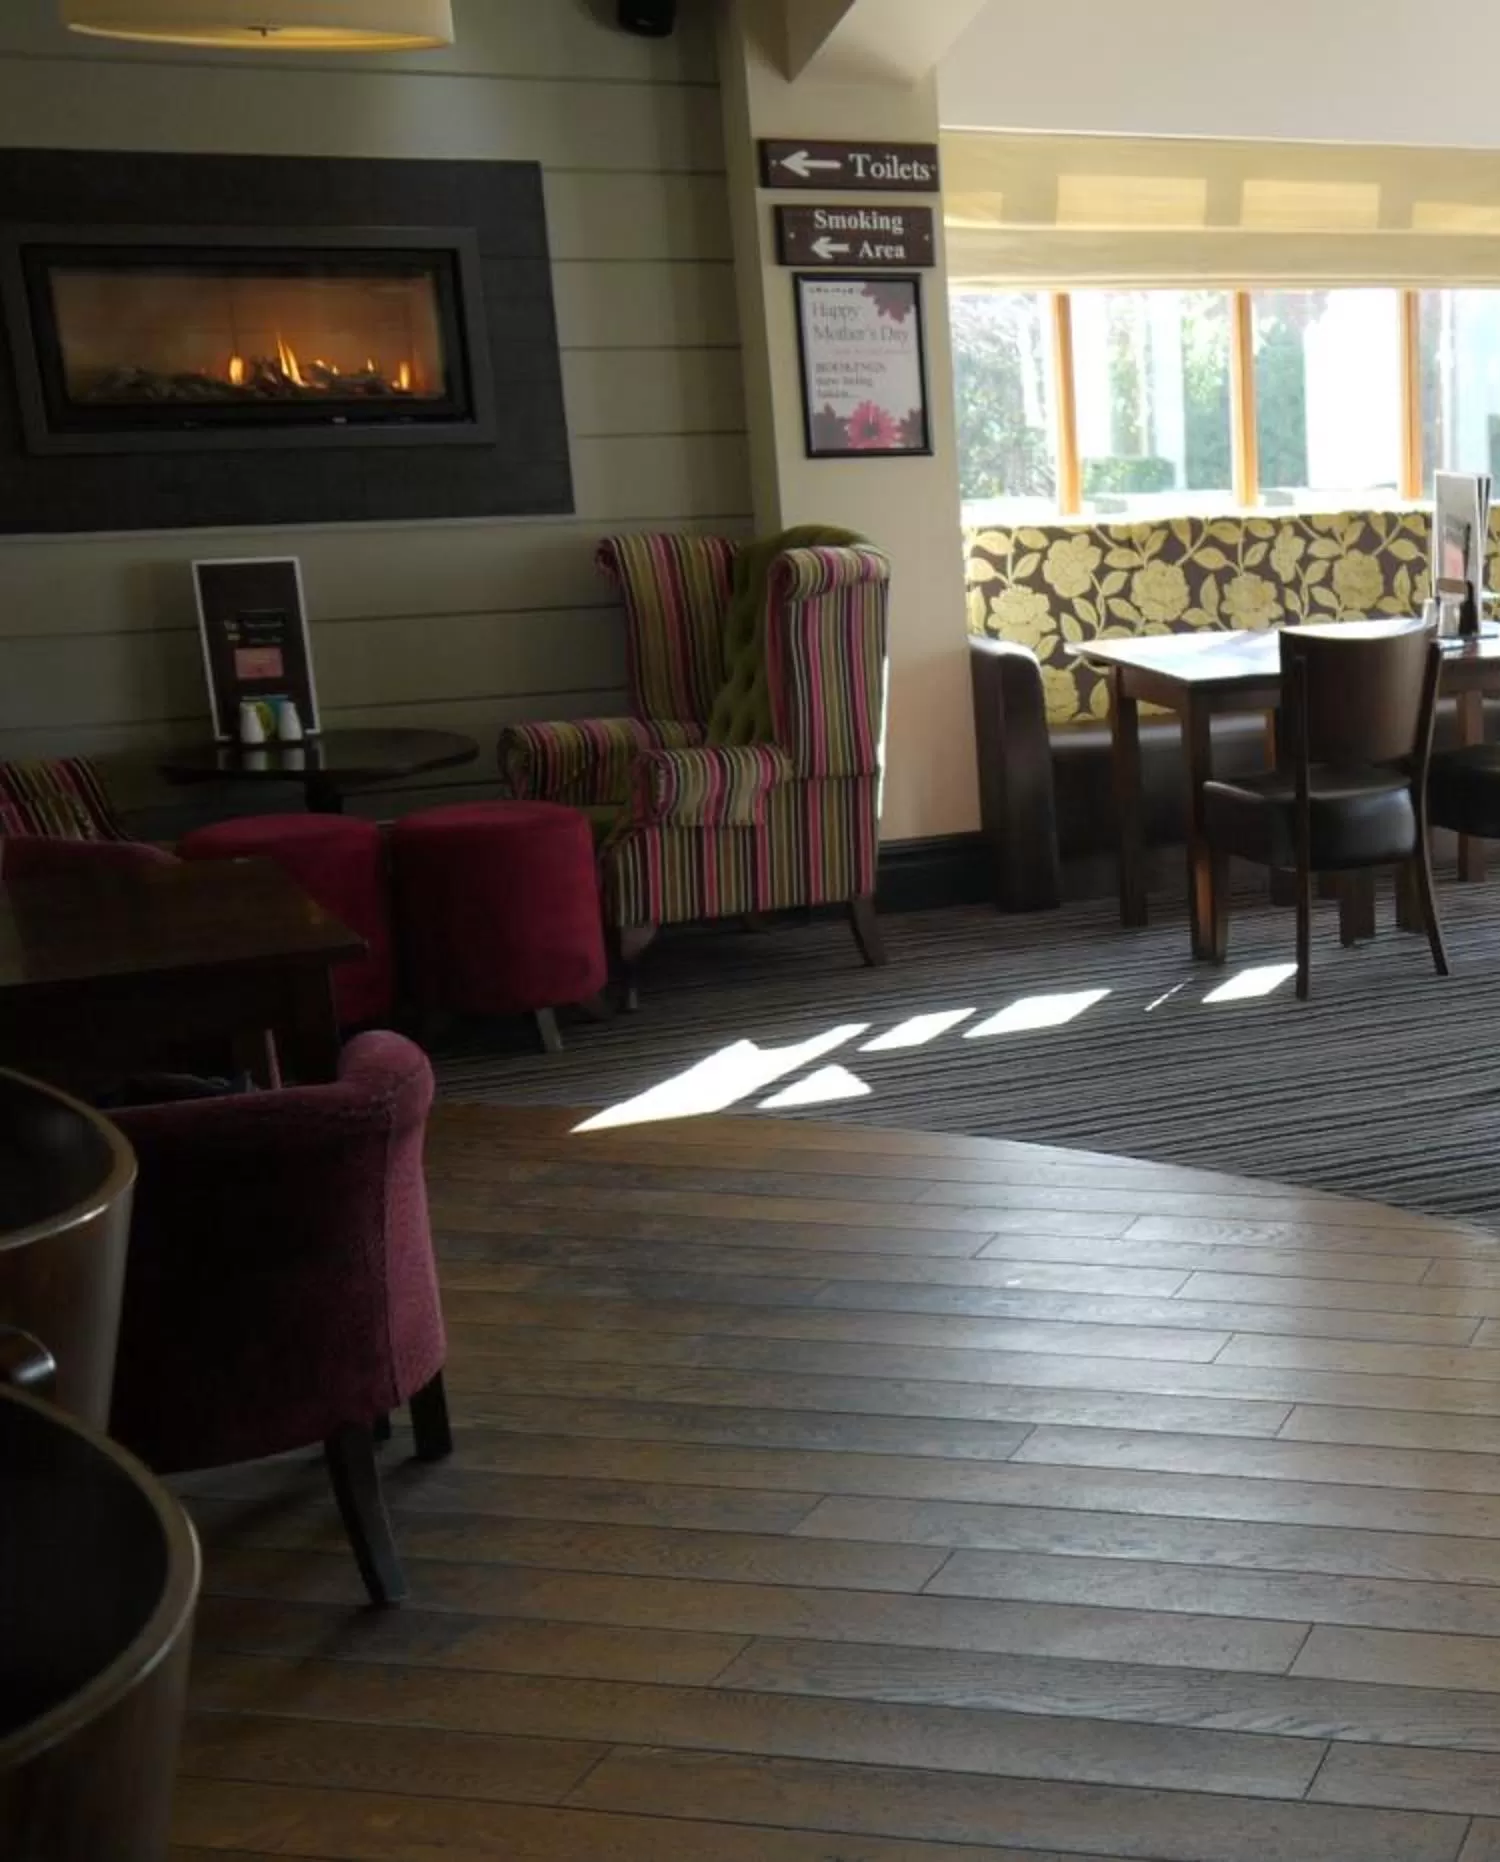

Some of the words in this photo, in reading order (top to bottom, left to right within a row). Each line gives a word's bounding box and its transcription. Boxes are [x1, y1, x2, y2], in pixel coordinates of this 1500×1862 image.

[848, 153, 931, 181] Toilets
[813, 209, 904, 235] Smoking
[859, 240, 906, 259] Area
[813, 302, 861, 322] Happy
[813, 325, 877, 342] Mother's
[881, 325, 909, 346] Day
